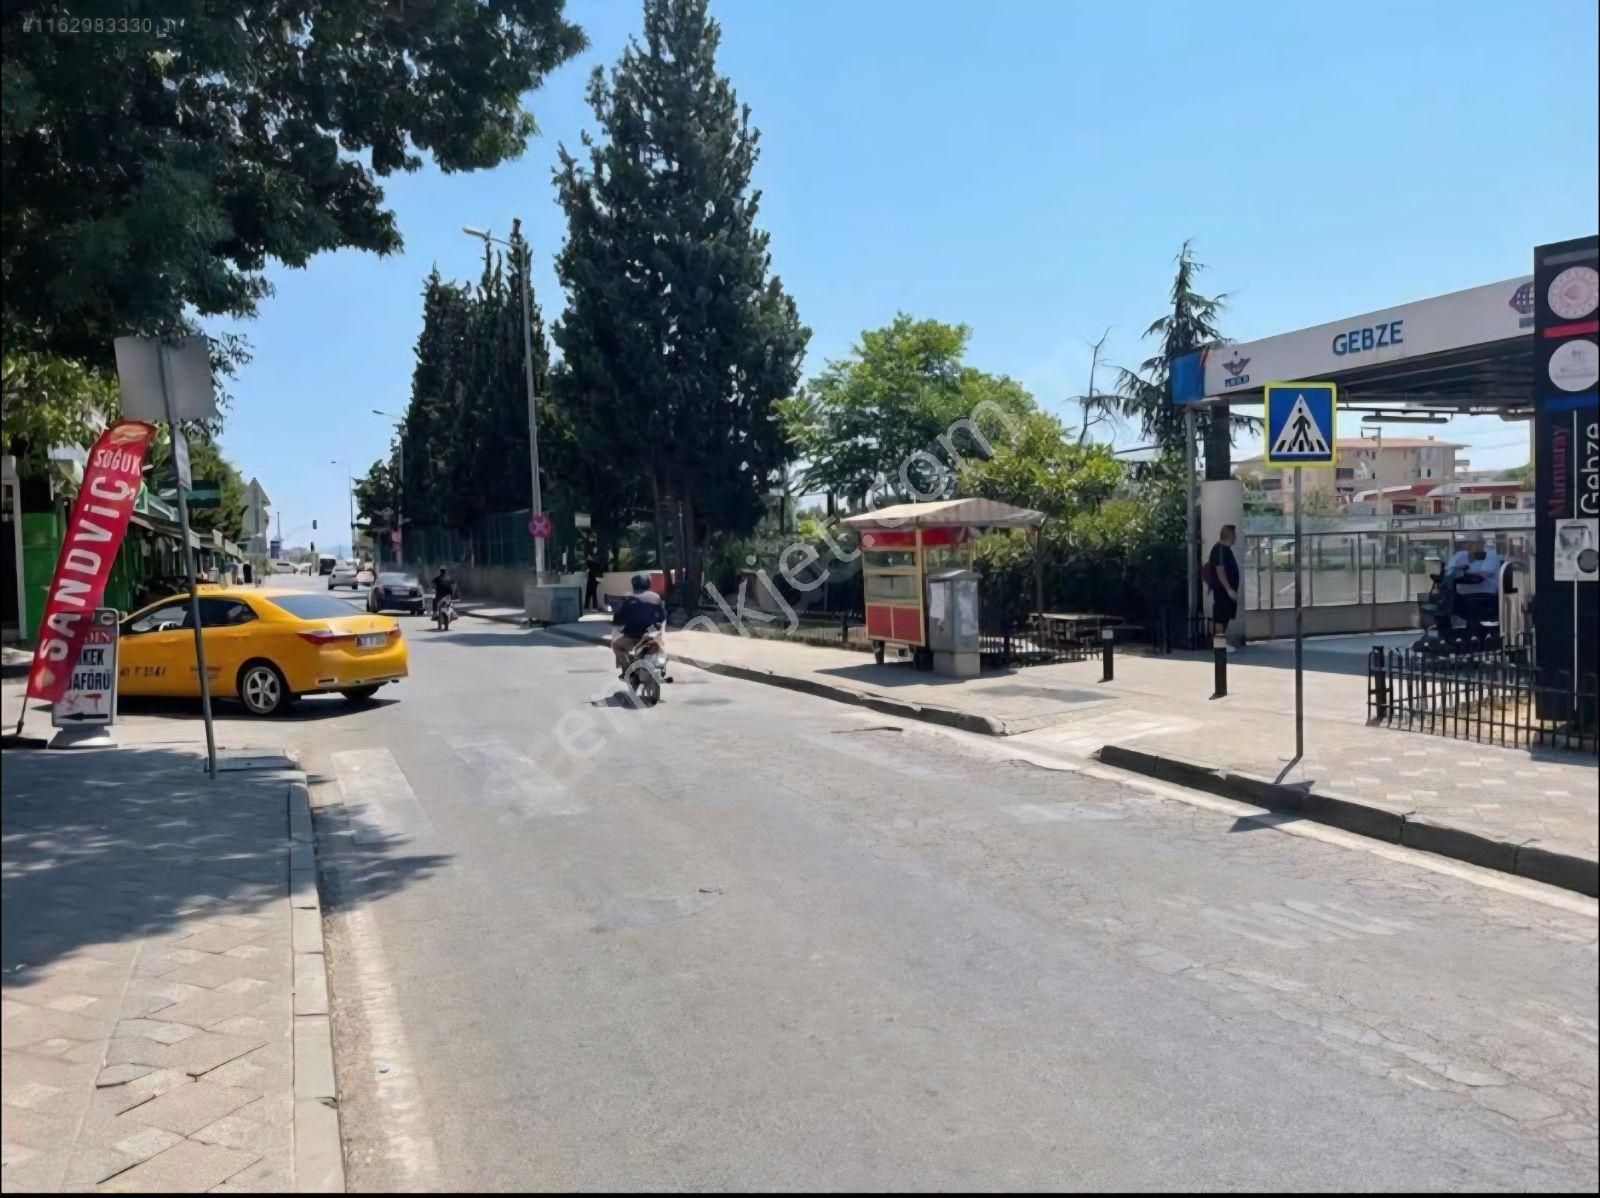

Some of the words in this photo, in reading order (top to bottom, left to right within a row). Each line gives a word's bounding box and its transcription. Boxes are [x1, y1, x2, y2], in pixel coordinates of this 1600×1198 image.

[1332, 319, 1404, 356] GEBZE
[93, 448, 142, 476] SOĞUK
[68, 669, 111, 690] AFÖRÜ
